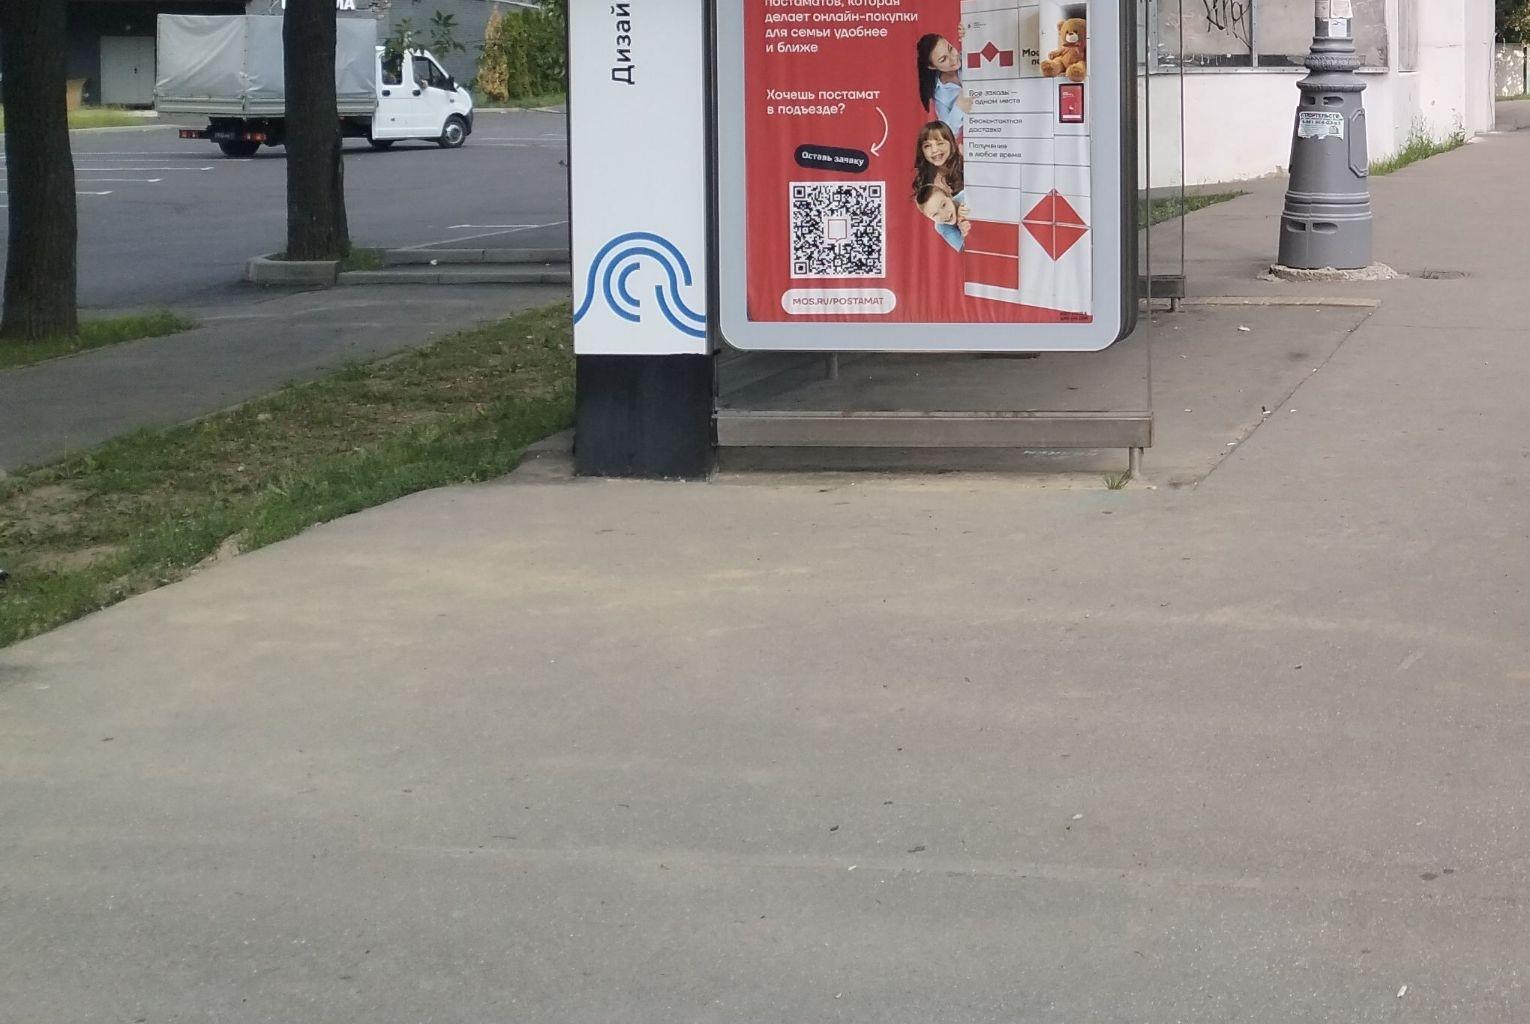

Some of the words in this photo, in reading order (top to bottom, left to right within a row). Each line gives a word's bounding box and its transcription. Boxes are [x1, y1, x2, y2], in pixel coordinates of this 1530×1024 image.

[764, 13, 811, 23] делает
[812, 10, 919, 24] онлайн-покупки
[765, 28, 788, 38] для
[790, 28, 831, 38] семьи
[834, 26, 888, 39] удобнее
[765, 43, 774, 53] и
[777, 41, 819, 53] ближе
[766, 89, 816, 100] Хочешь
[818, 90, 881, 100] постамат
[767, 106, 774, 115] в
[778, 103, 846, 116] подъезде?
[801, 151, 833, 162] Оставь
[834, 155, 865, 167] заявку
[792, 297, 885, 306] MOS.RU/POSTAMAT
